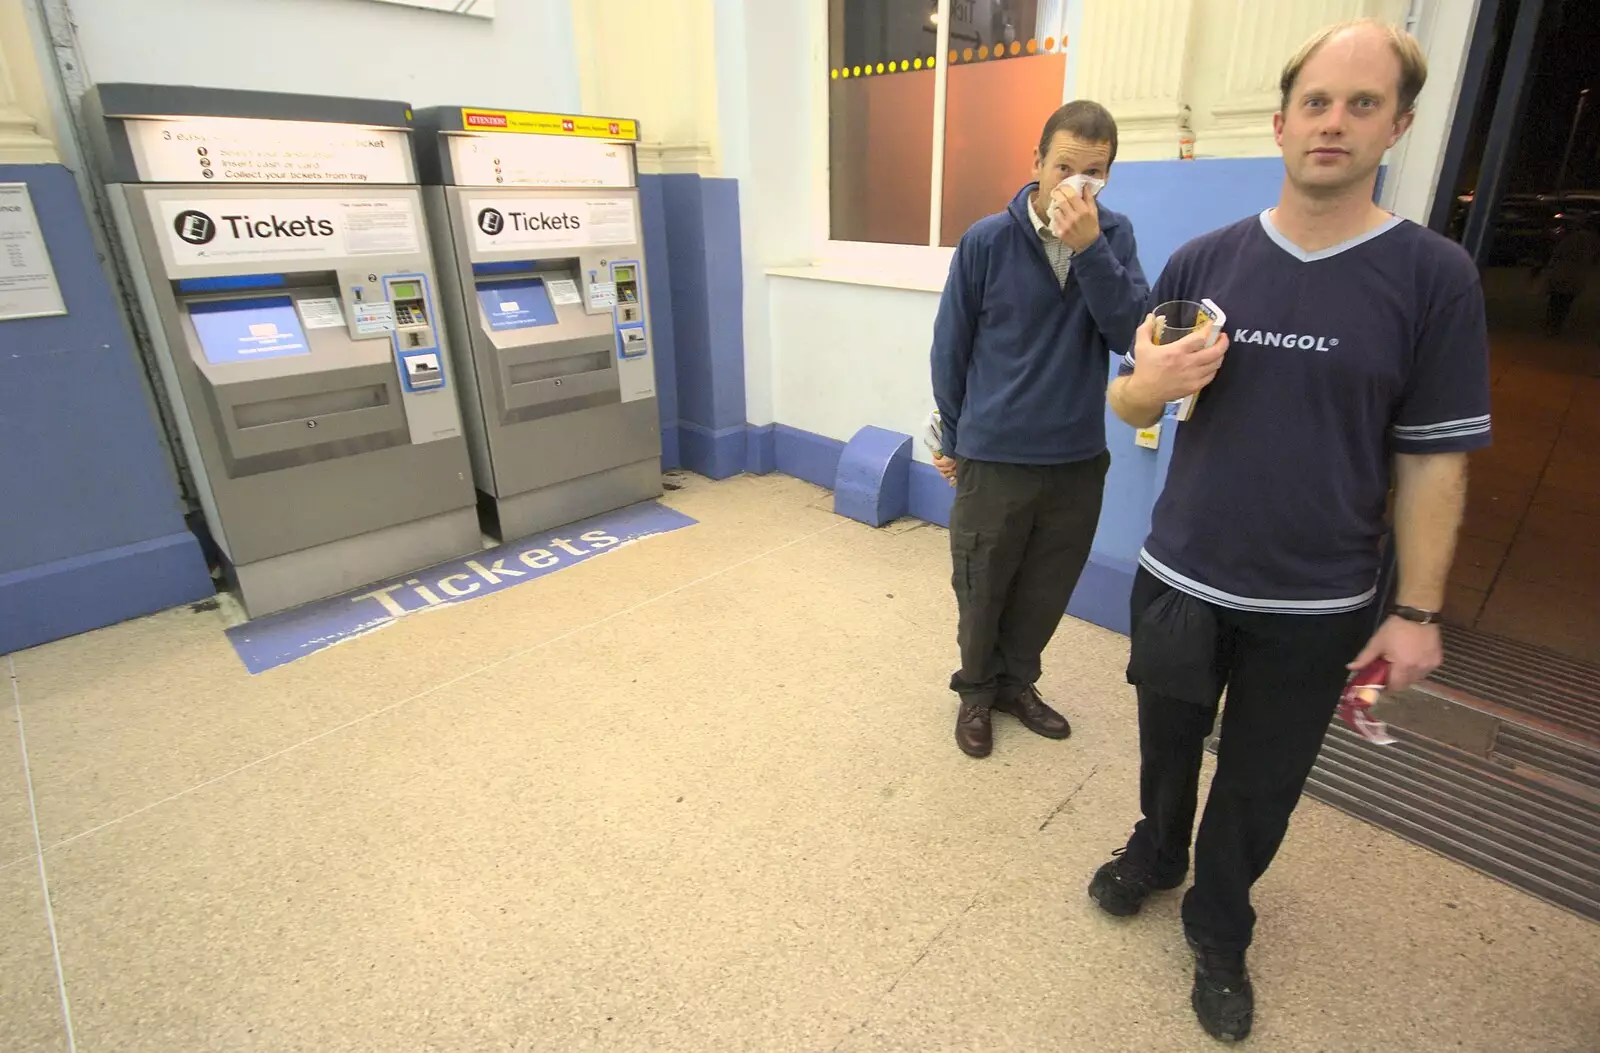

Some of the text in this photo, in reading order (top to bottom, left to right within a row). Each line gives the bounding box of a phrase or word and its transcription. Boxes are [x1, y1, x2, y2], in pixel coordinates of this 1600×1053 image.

[162, 129, 173, 141] 3
[224, 169, 261, 179] Collect
[264, 171, 287, 181] your
[350, 172, 368, 182] tray
[220, 214, 334, 239] Tickets
[507, 211, 581, 231] Tickets
[350, 529, 620, 617] Tickets
